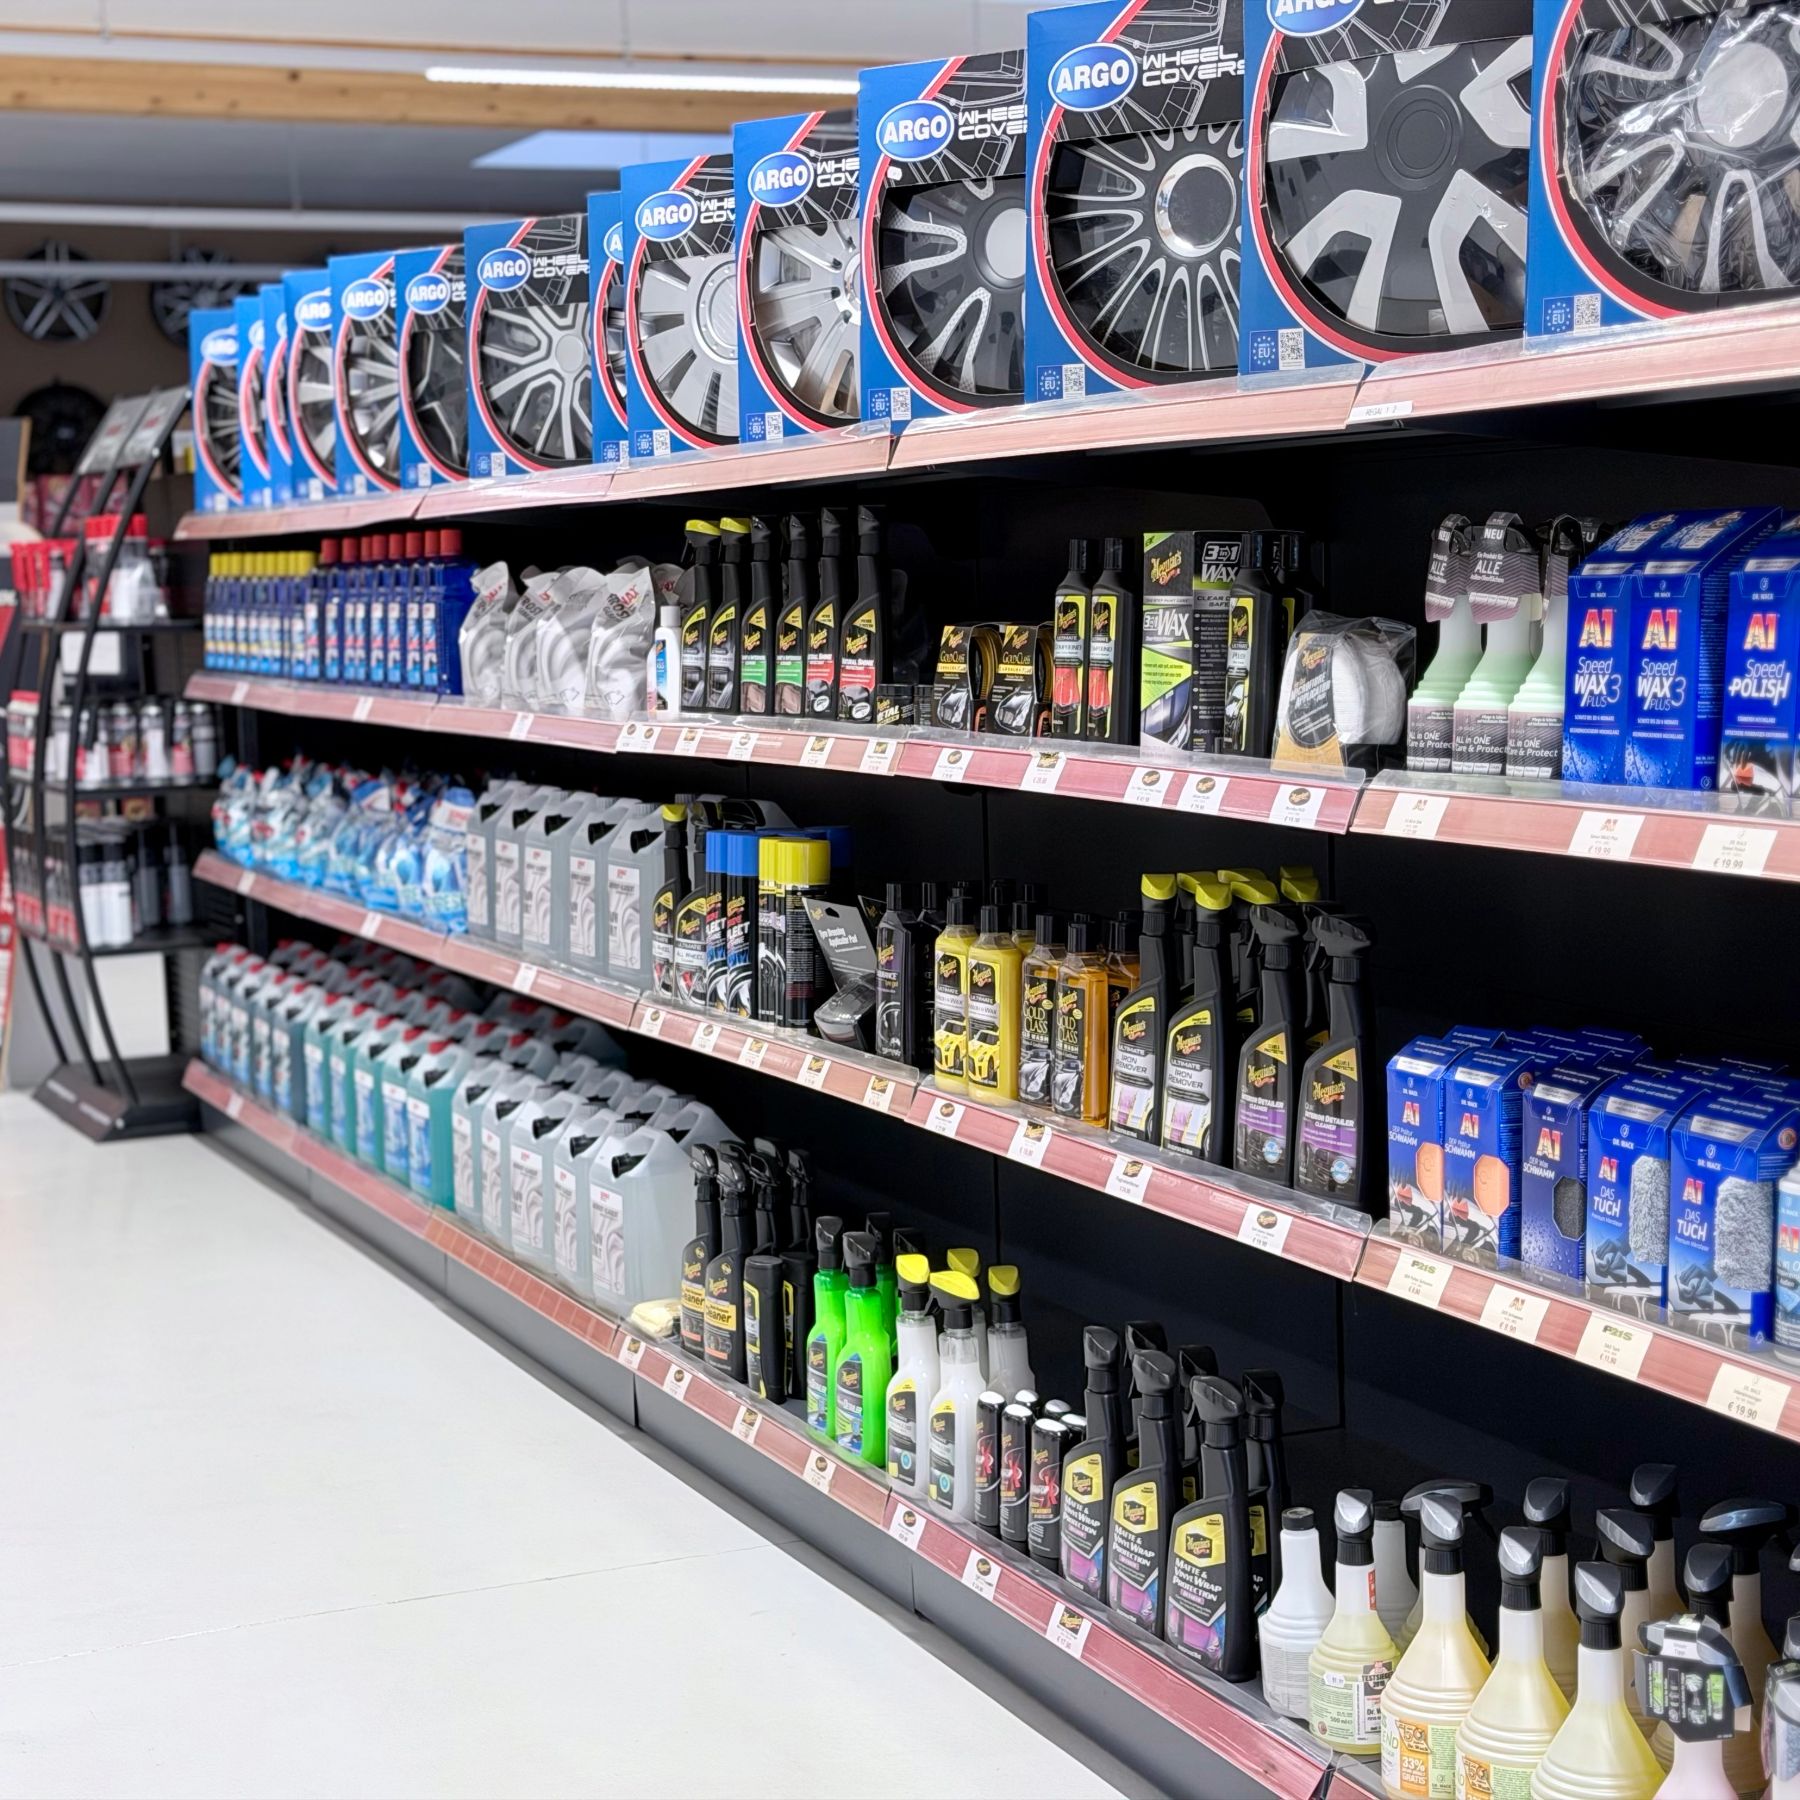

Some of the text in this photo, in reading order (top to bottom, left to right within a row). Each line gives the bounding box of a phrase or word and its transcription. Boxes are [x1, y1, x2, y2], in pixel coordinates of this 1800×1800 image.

[1142, 44, 1238, 70] WHEEL
[1056, 61, 1129, 93] ARGO
[884, 115, 947, 143] ARGO
[754, 164, 808, 190] ARGO
[640, 204, 693, 227] ARGO
[482, 260, 526, 277] ARGO
[533, 254, 589, 268] WHEEL
[346, 290, 386, 308] ARGO
[409, 285, 447, 301] ARGO
[1552, 313, 1565, 325] EU
[1257, 346, 1270, 359] EU
[1044, 379, 1055, 391] EU
[1438, 531, 1450, 542] NEU
[1484, 528, 1504, 539] NEU
[1201, 564, 1238, 582] WAX
[1431, 560, 1447, 575] ALLE
[1475, 561, 1502, 575] ALLE
[1158, 609, 1190, 640] WAX
[1579, 608, 1613, 648] A1
[1642, 609, 1678, 650] A1
[1743, 613, 1777, 650] A1
[1577, 656, 1613, 675] Speed
[1641, 658, 1677, 677] Speed
[1745, 659, 1786, 678] Speed
[1574, 674, 1622, 707] WAX 3
[1637, 676, 1686, 711] WAX 3
[1728, 672, 1791, 707] POLISH
[1586, 696, 1608, 708] PLUS
[1650, 698, 1672, 711] PLUS
[1424, 731, 1441, 742] ONE
[1474, 735, 1491, 745] ONE
[1523, 739, 1541, 748] ONE
[1526, 748, 1558, 758] Protect
[1721, 860, 1744, 869] 19.99
[1023, 1000, 1045, 1020] GOLD
[1024, 1018, 1048, 1033] CLASS
[1119, 1045, 1145, 1055] ULTIMATE
[1116, 1060, 1147, 1074] REMOVER
[1122, 1055, 1137, 1064] IRON
[1171, 1059, 1201, 1070] ULTIMATE
[1169, 1074, 1203, 1089] REMOVER
[1175, 1069, 1192, 1079] IRON
[1248, 1064, 1276, 1088] Meguiar's
[1313, 1081, 1345, 1105] Meguiar's
[1258, 1097, 1284, 1108] DETAILER
[1325, 1115, 1354, 1127] DETAILER
[1402, 1101, 1420, 1127] A1
[1315, 1121, 1336, 1131] CLEANER
[1460, 1112, 1480, 1139] A1
[1389, 1130, 1417, 1147] SCHWAMM
[1536, 1127, 1562, 1161] A1
[1621, 1140, 1634, 1150] WACK
[1444, 1144, 1476, 1161] SCHWAMM
[1529, 1156, 1539, 1165] DER
[1523, 1162, 1555, 1181] SCHWAMM
[1598, 1156, 1618, 1183] A1
[1697, 1158, 1721, 1171] DR. WACK
[1601, 1185, 1615, 1200] DAS
[1683, 1177, 1704, 1205] A1
[1593, 1194, 1621, 1218] TUCH
[1685, 1208, 1701, 1223] DAS
[1676, 1219, 1707, 1242] TUCH
[1779, 1224, 1800, 1253] A1
[1411, 1260, 1437, 1274] P21S
[1603, 1325, 1632, 1341] P21S
[1728, 1401, 1758, 1421] € 19.90
[1079, 1514, 1101, 1527] WRAP
[1115, 1524, 1142, 1545] MATTE &
[1113, 1542, 1151, 1567] PROTECTION
[1130, 1541, 1155, 1558] WRAP
[1176, 1558, 1208, 1579] MATTE &
[1175, 1567, 1222, 1592] VINYL WRAP
[1173, 1576, 1217, 1601] PROTECTION
[1402, 1756, 1425, 1771] 33%
[1402, 1773, 1426, 1785] GRATIS
